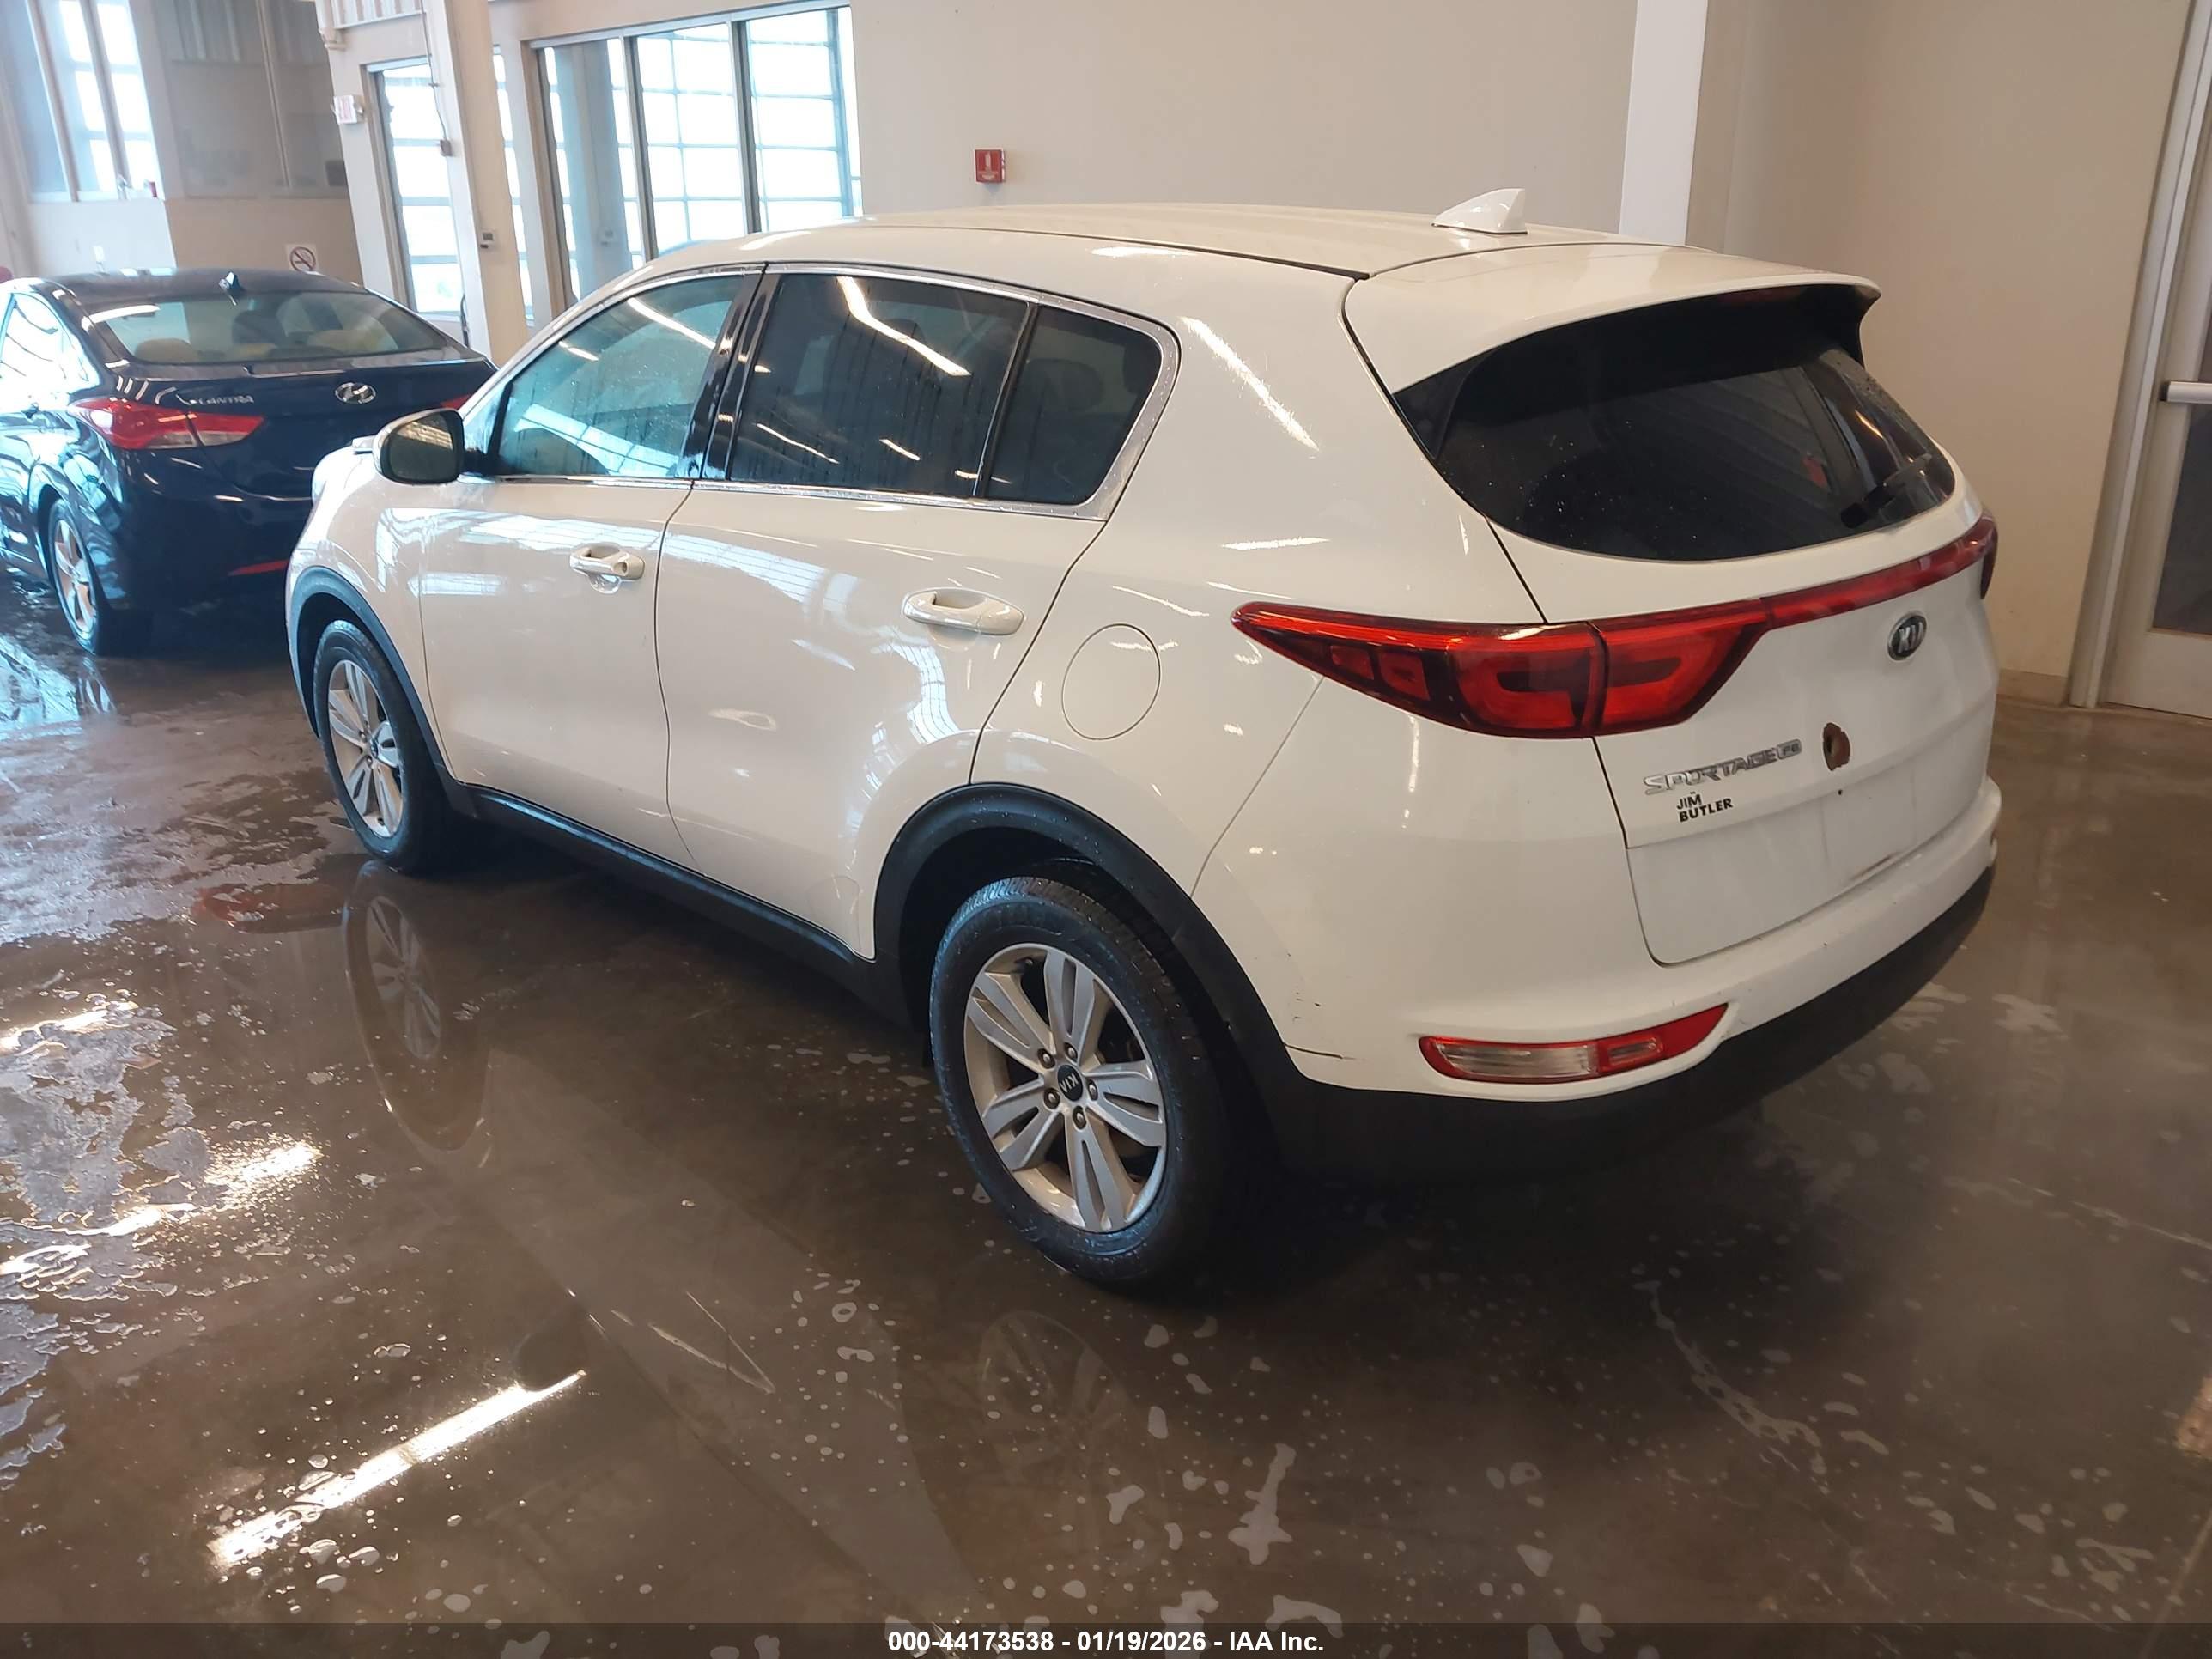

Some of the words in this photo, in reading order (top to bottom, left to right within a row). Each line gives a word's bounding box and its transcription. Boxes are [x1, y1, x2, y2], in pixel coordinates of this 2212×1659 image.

[1896, 621, 1924, 653] KIA
[1644, 745, 1778, 795] SPORTAGE
[1677, 794, 1702, 810] JIM
[1679, 798, 1733, 823] BUTLER
[1059, 1073, 1079, 1093] KIA
